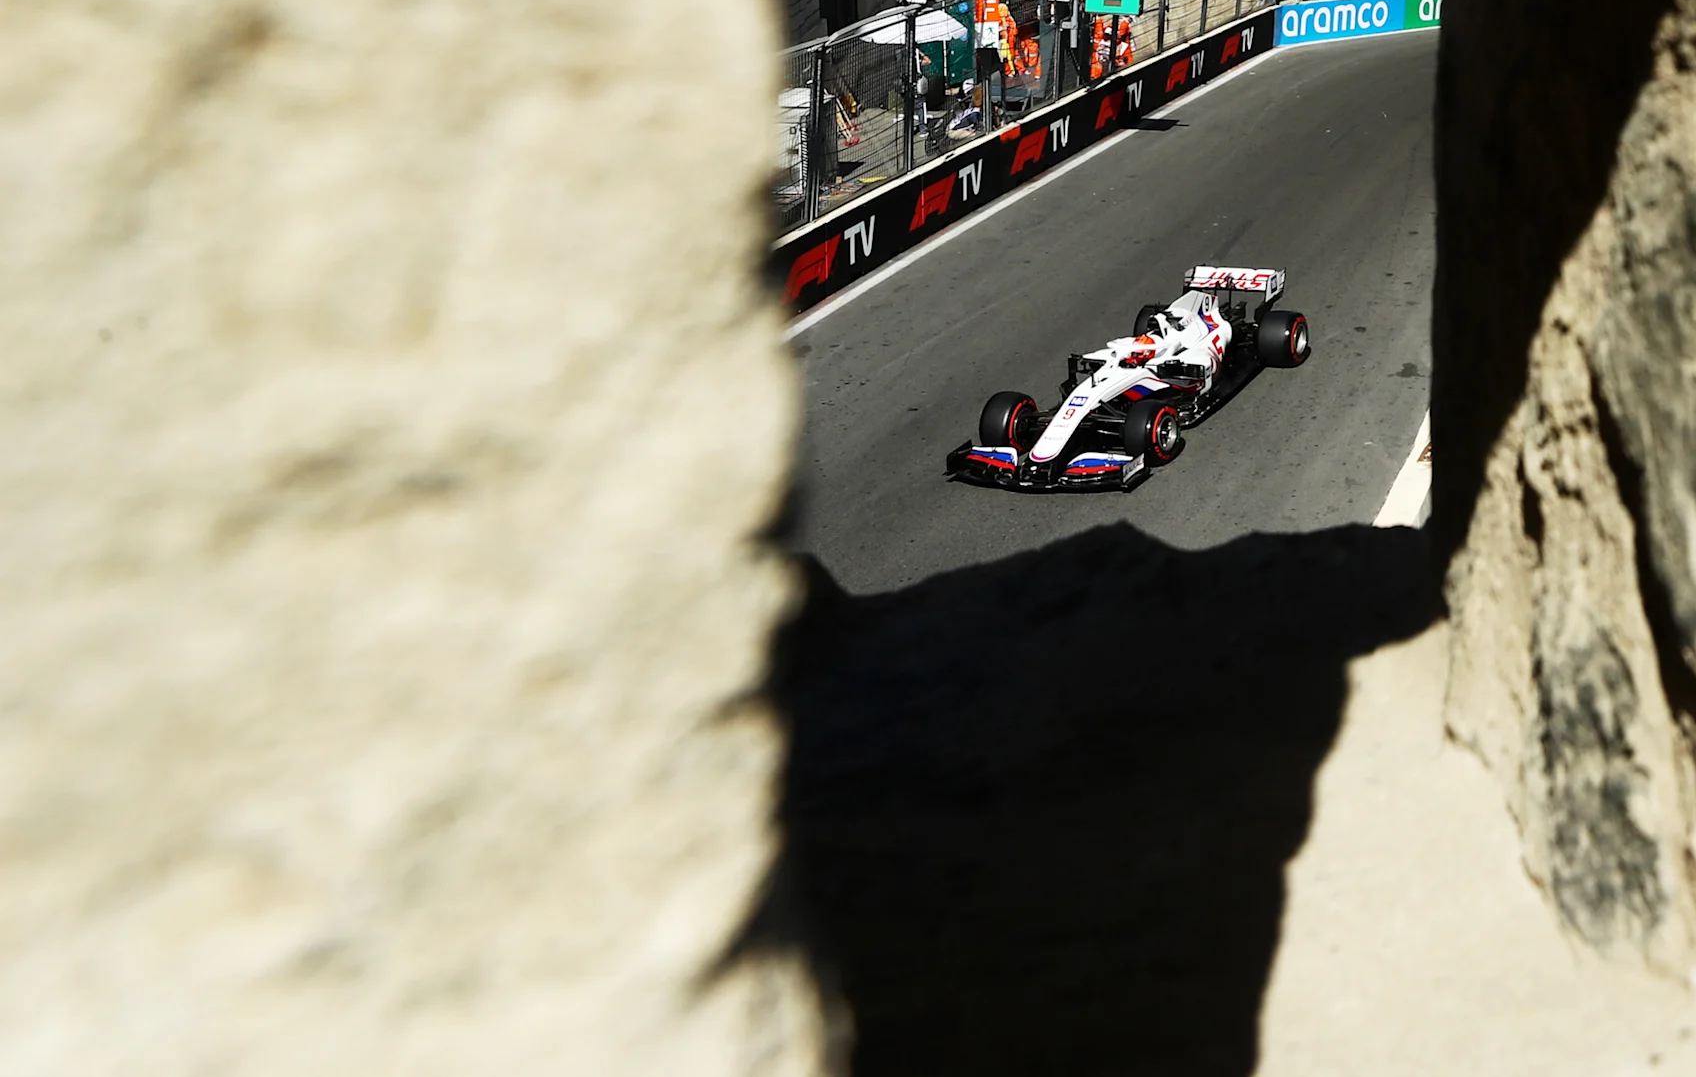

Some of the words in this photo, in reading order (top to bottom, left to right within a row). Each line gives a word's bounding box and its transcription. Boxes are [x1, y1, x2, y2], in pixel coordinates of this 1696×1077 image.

[1282, 1, 1389, 38] aramco
[1241, 26, 1255, 53] TV
[1190, 50, 1205, 81] TV
[1126, 79, 1143, 109] TV
[1049, 115, 1070, 152] TV
[958, 158, 983, 202] TV
[843, 215, 875, 265] TV
[1063, 408, 1076, 420] 9
